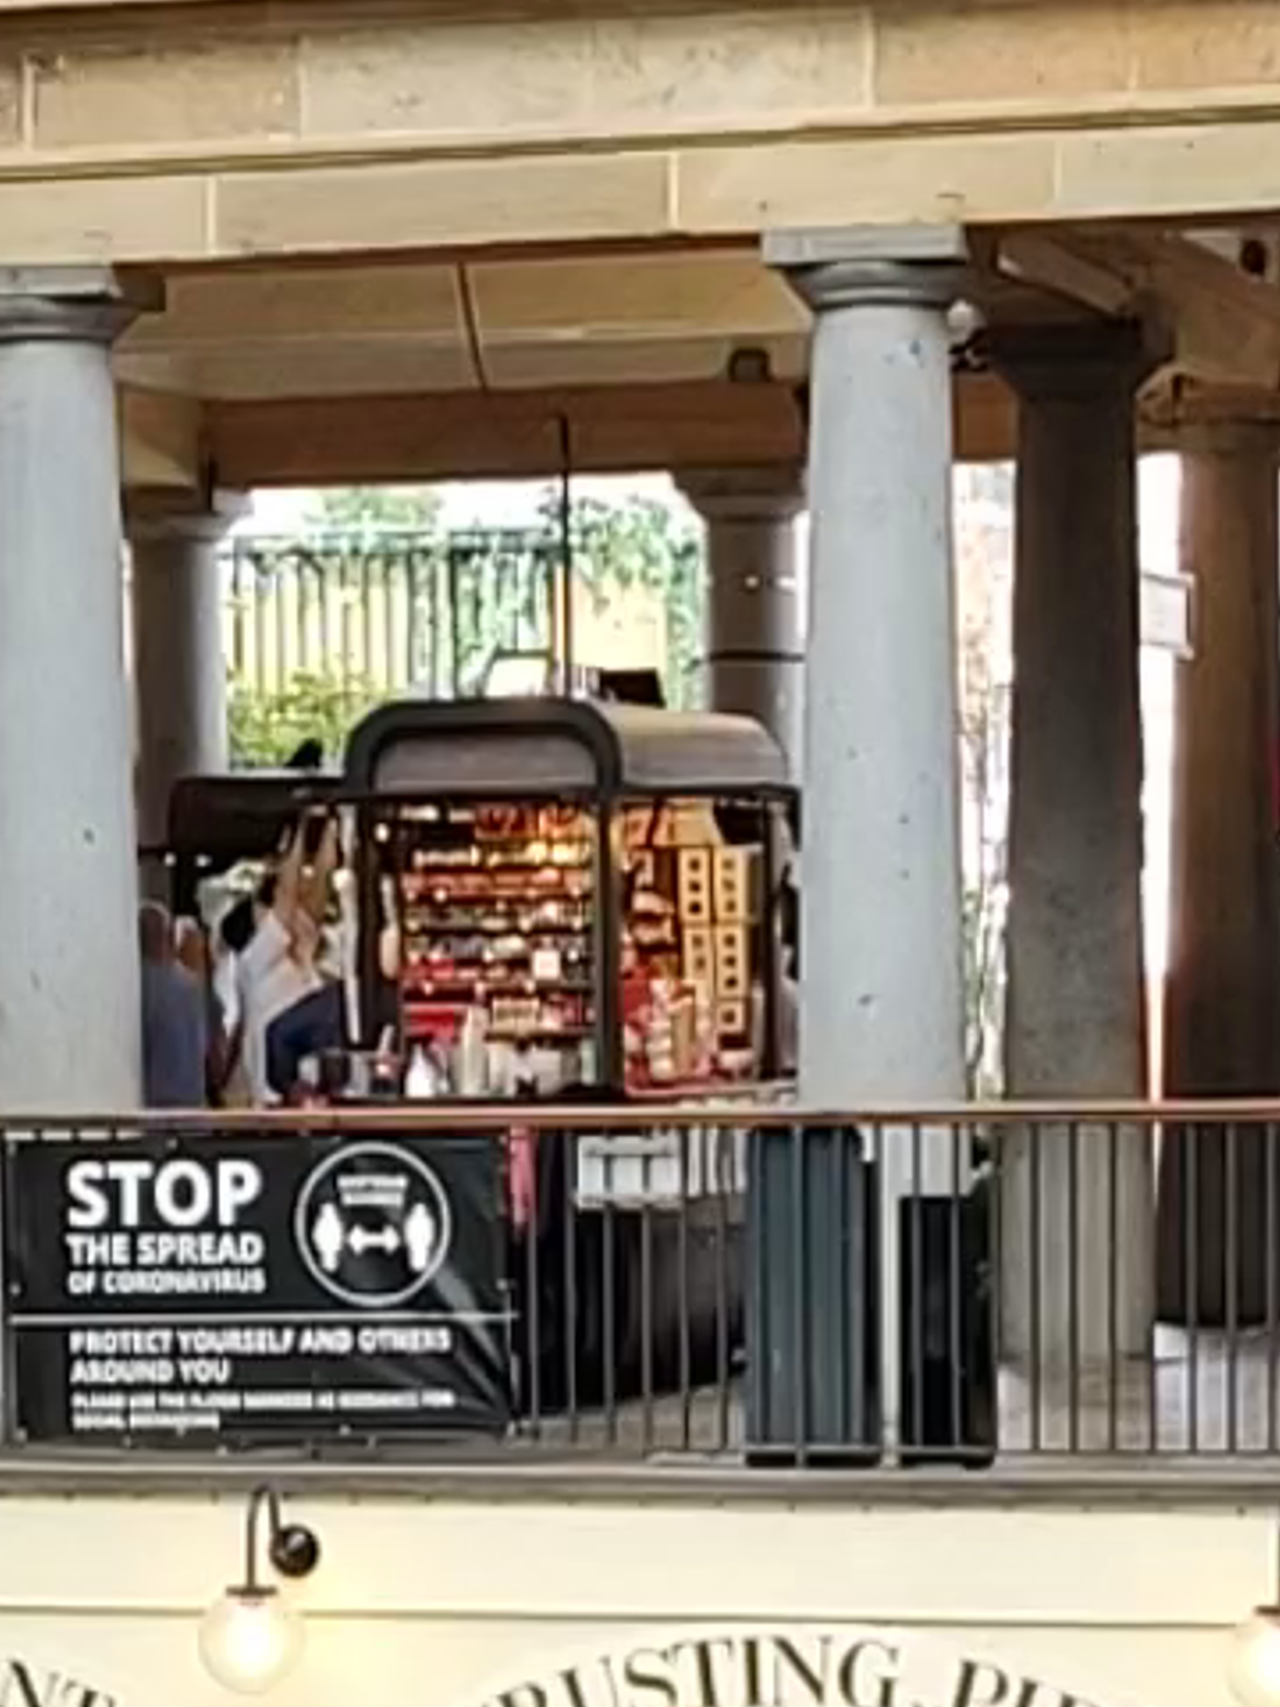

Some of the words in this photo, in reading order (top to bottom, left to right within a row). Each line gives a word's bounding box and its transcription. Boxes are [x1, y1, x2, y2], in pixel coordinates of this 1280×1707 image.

[66, 1160, 262, 1227] STOP
[66, 1232, 131, 1266] THE
[136, 1231, 265, 1266] SPREAD
[68, 1271, 96, 1294] OF
[103, 1269, 267, 1294] CORONAVIRUS
[69, 1329, 173, 1354] PROTECT
[177, 1329, 295, 1354] YOURSELF
[299, 1328, 353, 1353] AND
[357, 1327, 452, 1353] OTHERS
[70, 1358, 173, 1384] AROUND
[178, 1358, 231, 1384] YOU
